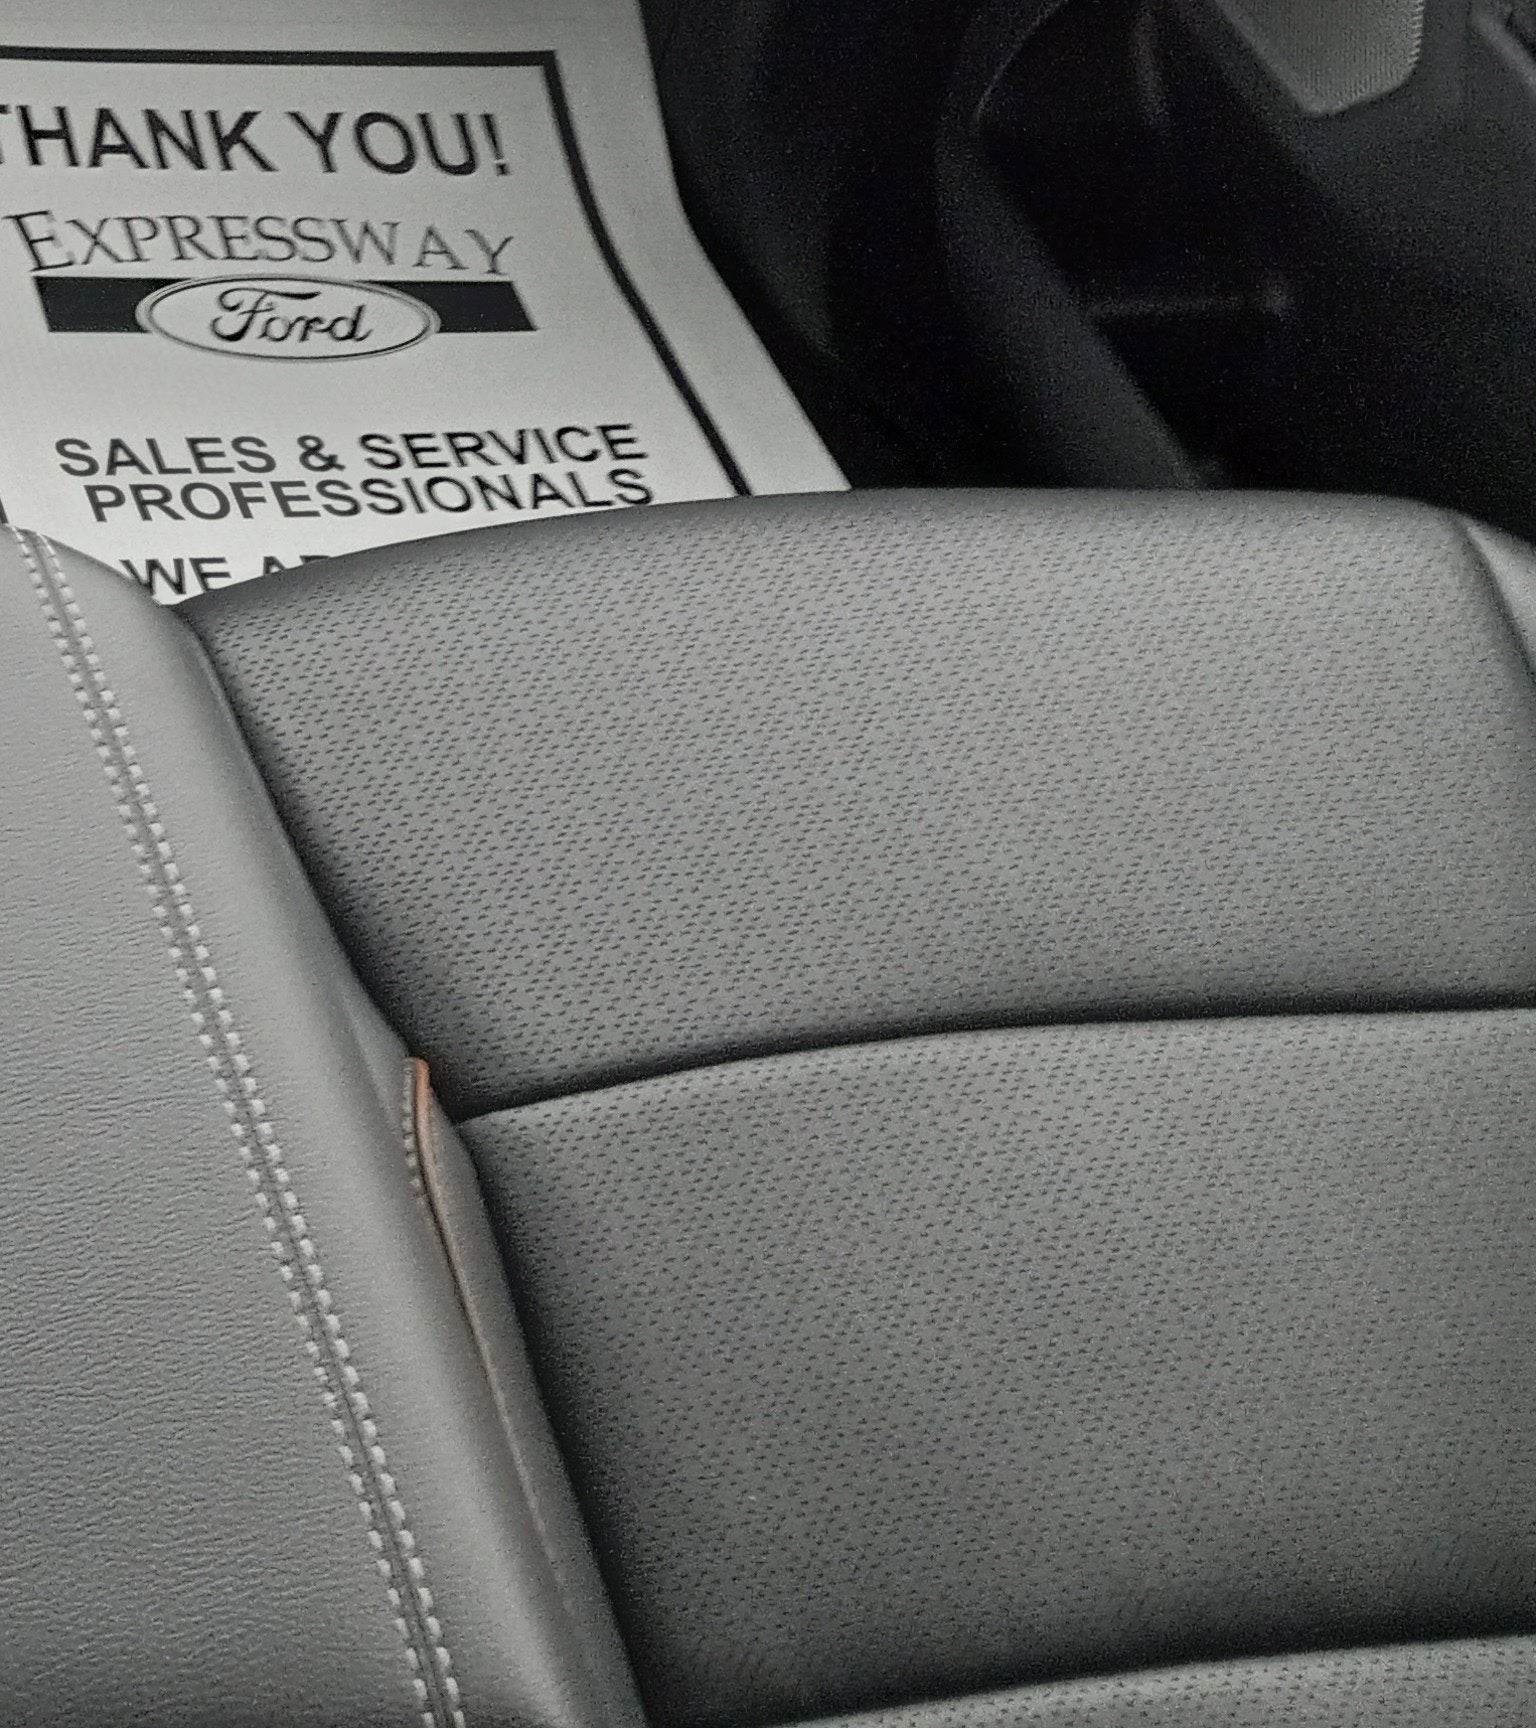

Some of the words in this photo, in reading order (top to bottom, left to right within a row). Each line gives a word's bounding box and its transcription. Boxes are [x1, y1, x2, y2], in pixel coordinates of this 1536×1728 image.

[286, 109, 513, 177] YOU!
[3, 208, 515, 276] EXPRESSWAY
[209, 286, 374, 345] Ford
[54, 434, 277, 478] SALES
[297, 433, 346, 472] &
[359, 423, 649, 471] SERVICE
[82, 470, 655, 524] PROFESSIONALS
[119, 557, 232, 597] WE
